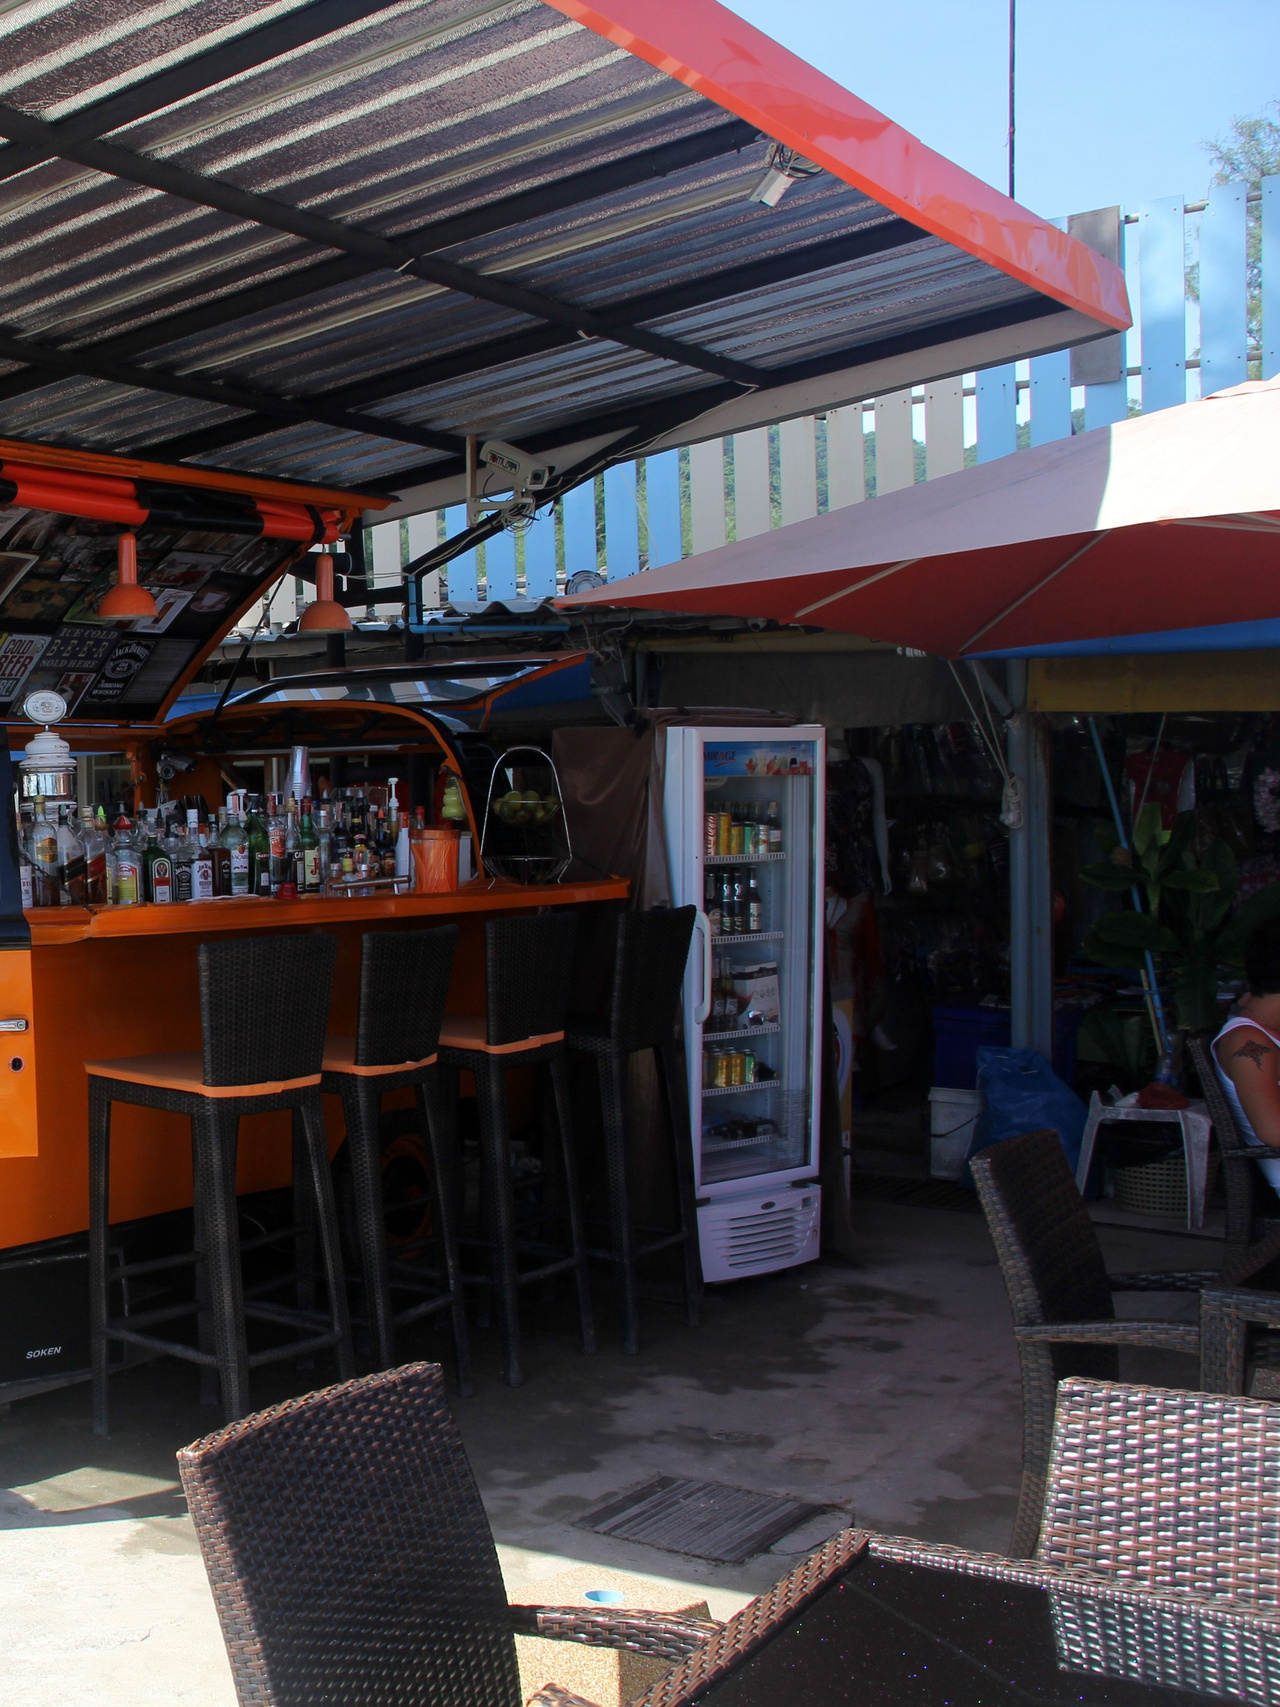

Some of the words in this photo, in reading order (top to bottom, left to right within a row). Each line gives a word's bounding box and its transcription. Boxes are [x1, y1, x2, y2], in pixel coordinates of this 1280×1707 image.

[58, 628, 83, 637] ICE
[84, 629, 118, 640] COLD
[4, 638, 34, 655] COLD
[39, 659, 69, 668] SOLD
[67, 659, 99, 669] HERE
[25, 1346, 62, 1360] SOKEN
